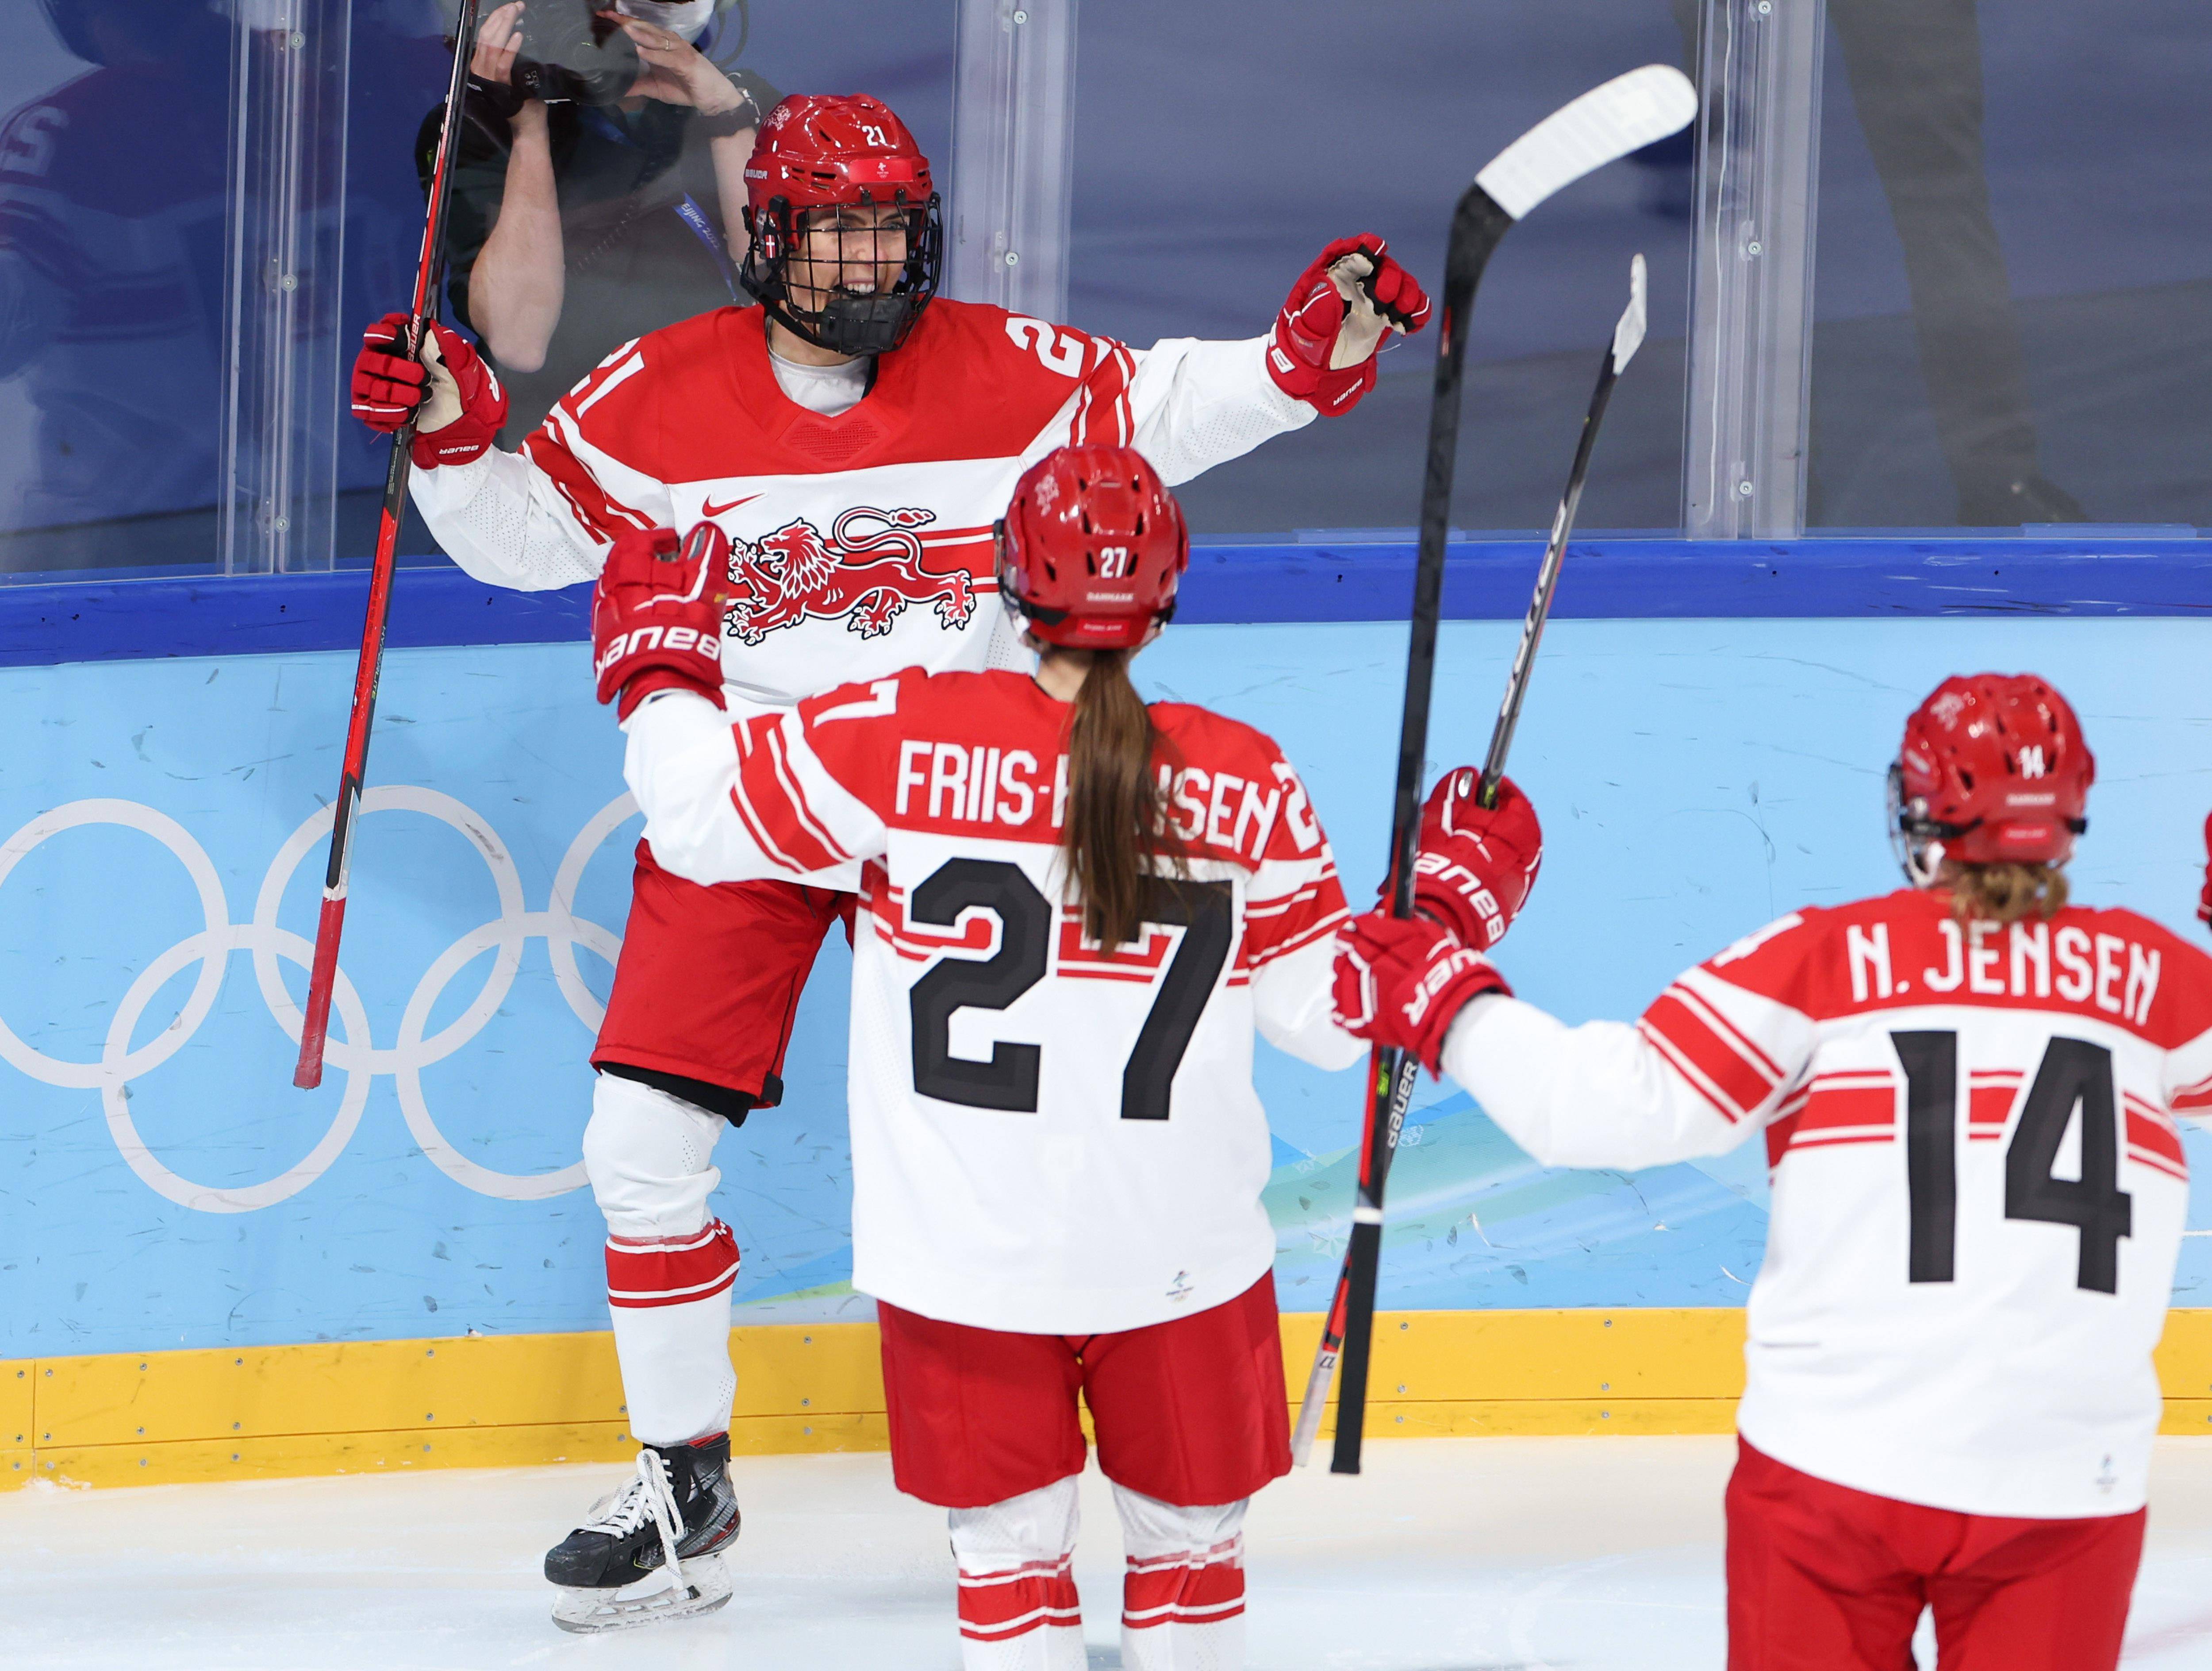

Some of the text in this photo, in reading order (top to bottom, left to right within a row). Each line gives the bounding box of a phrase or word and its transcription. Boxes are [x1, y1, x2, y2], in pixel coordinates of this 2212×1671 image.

[862, 125, 886, 146] 21
[681, 202, 706, 228] EIJING
[1005, 310, 1085, 378] 2
[1333, 377, 1363, 406] BAUER
[438, 444, 479, 455] BAUER
[1100, 546, 1128, 578] 27
[1270, 761, 1321, 853] 2
[1414, 851, 1506, 943] BAUE
[909, 856, 1233, 1121] 27
[1402, 946, 1498, 1027] UER
[1846, 922, 1910, 1003] N.
[1923, 918, 2161, 1026] JENSEN
[1387, 1059, 1418, 1149] BAUER
[1889, 1030, 2132, 1296] 14
